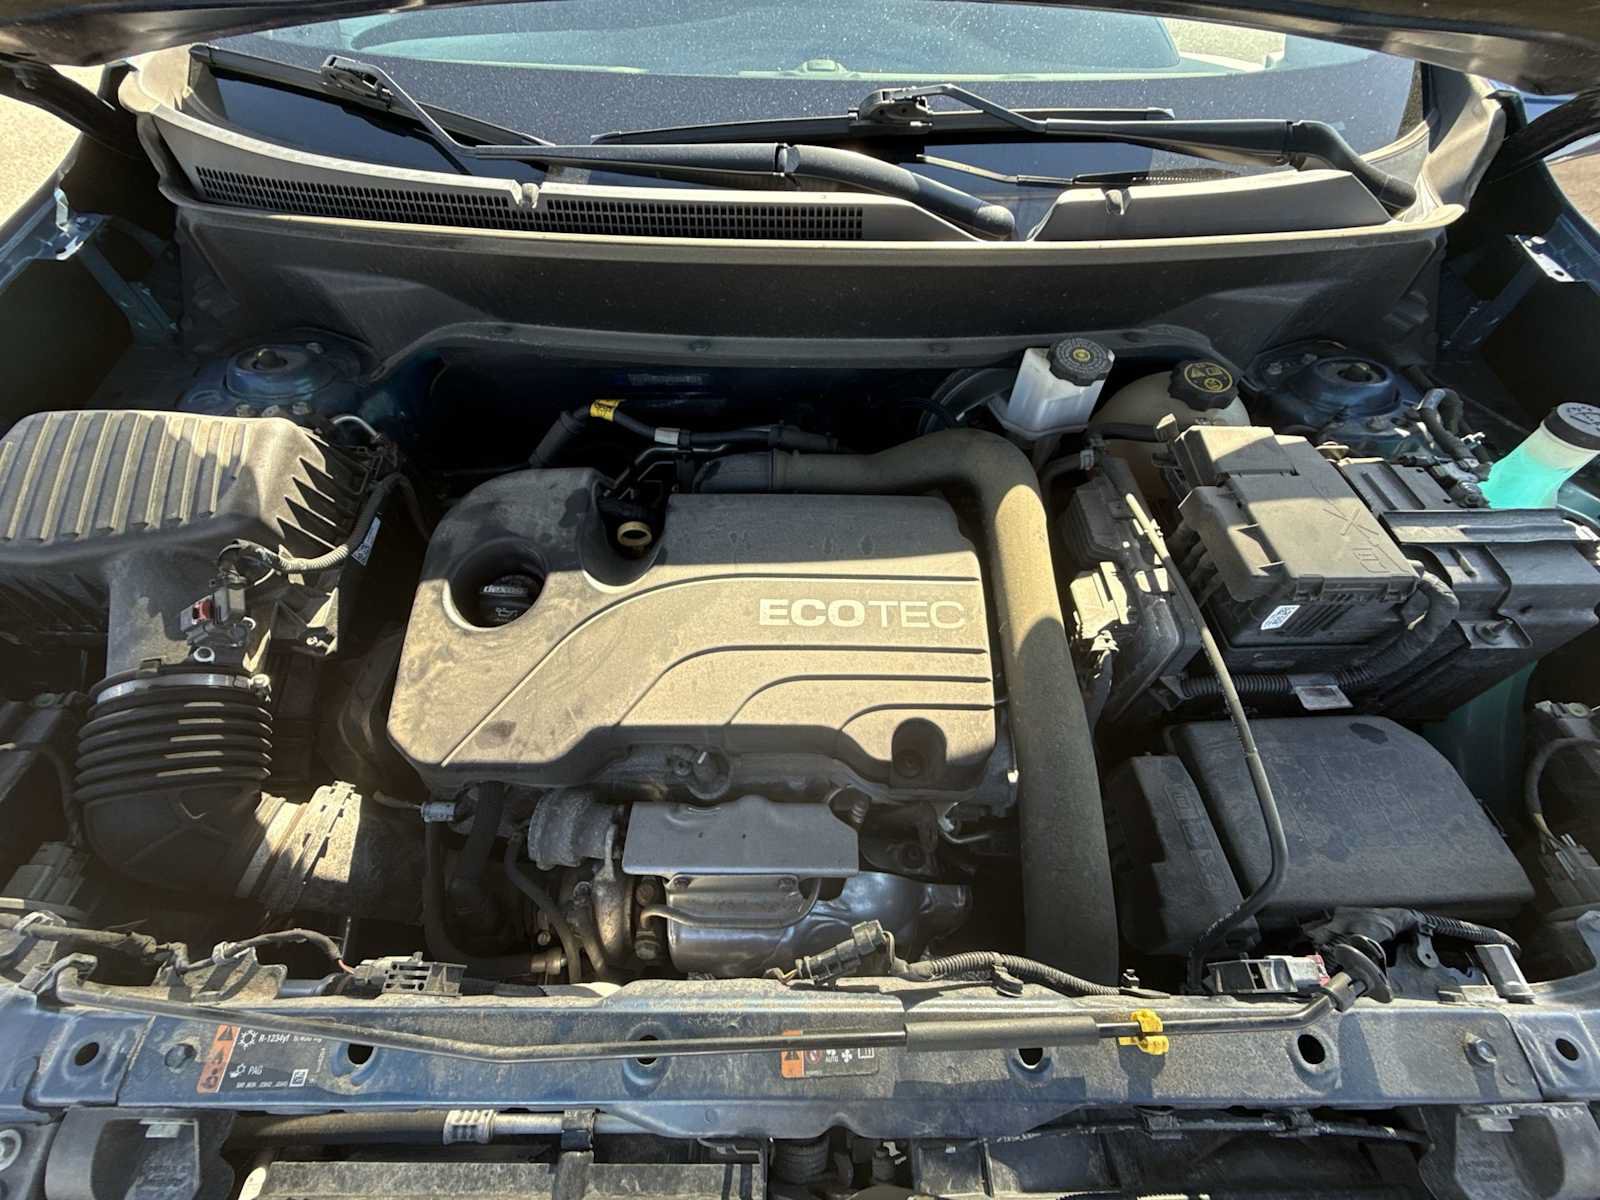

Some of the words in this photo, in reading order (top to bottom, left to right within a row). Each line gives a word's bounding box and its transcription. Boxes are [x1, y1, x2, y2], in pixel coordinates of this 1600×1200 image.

[759, 598, 966, 629] ECOTEC
[258, 1034, 290, 1043] R-1234yf
[825, 1055, 839, 1063] AUTO
[248, 1065, 263, 1075] PAG
